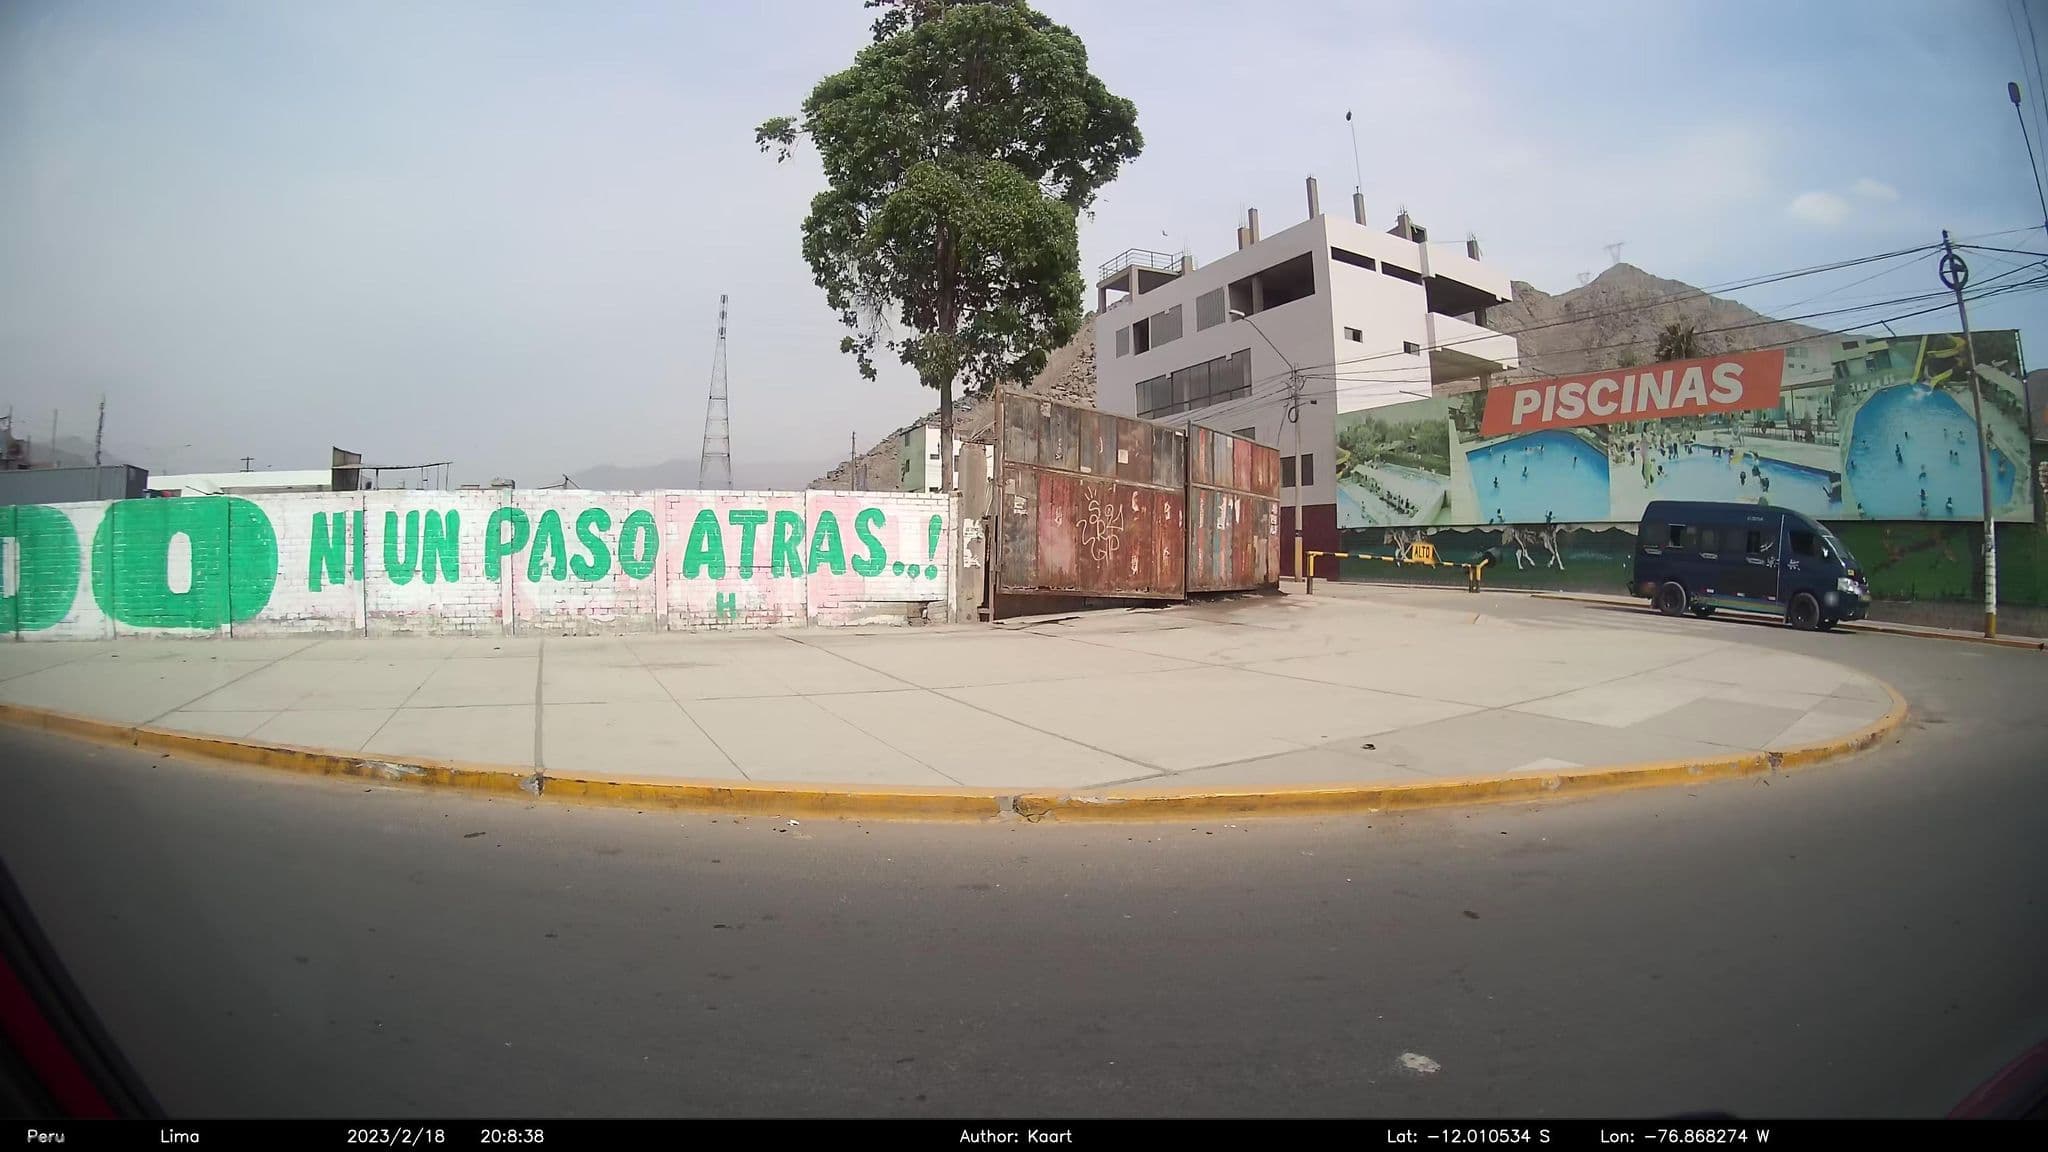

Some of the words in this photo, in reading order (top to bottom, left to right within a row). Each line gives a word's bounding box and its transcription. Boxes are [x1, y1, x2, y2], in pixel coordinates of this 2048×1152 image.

[1511, 362, 1745, 426] PISCINAS
[309, 511, 364, 592] NI
[384, 509, 461, 585] UN
[484, 507, 658, 582] PASO
[1414, 545, 1430, 559] ALTO
[717, 592, 738, 620] H
